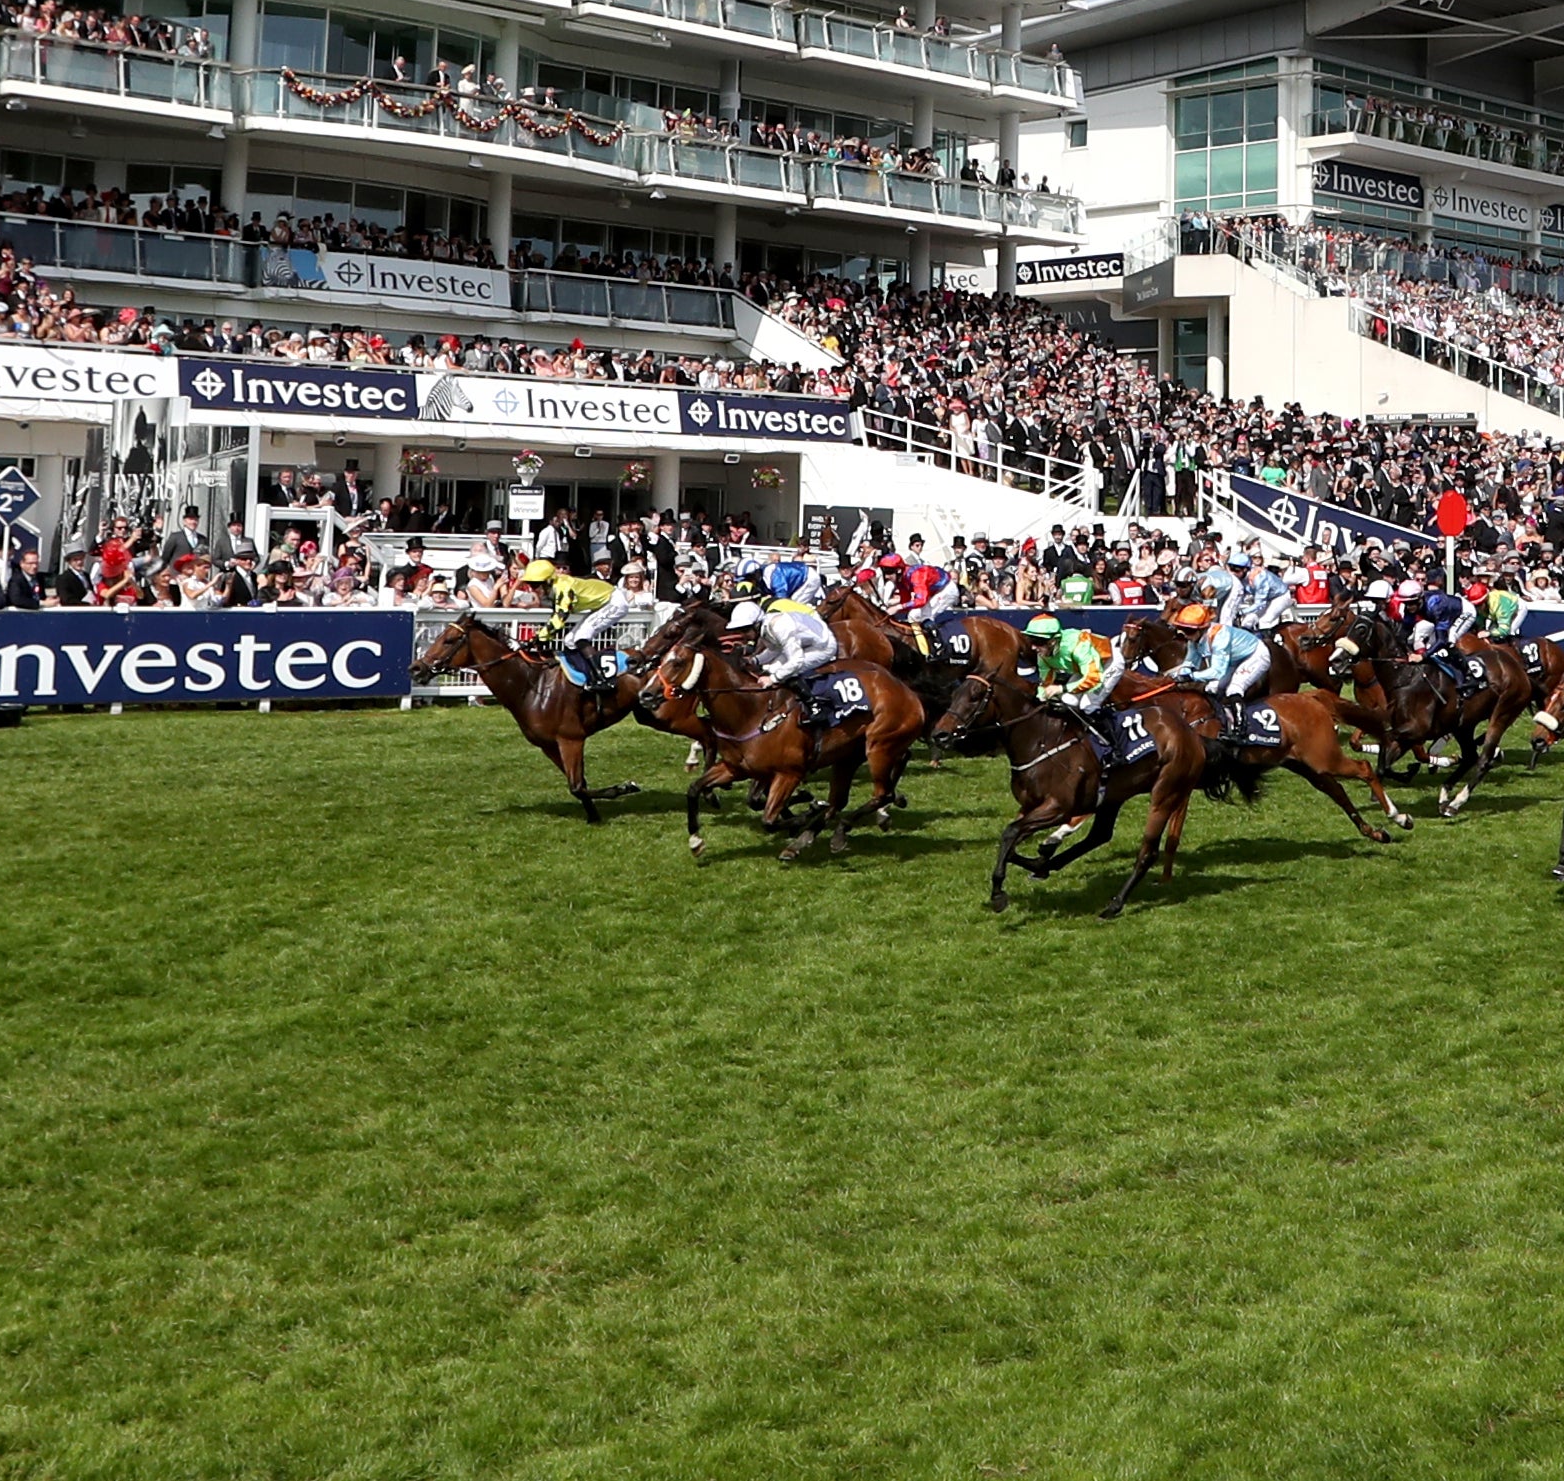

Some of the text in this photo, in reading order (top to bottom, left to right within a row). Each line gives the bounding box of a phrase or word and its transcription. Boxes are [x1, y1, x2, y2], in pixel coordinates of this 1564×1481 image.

[1332, 165, 1420, 204] Investec
[1451, 187, 1528, 224] Investec
[368, 263, 492, 299] Investec
[943, 271, 980, 289] stec
[1035, 258, 1122, 283] Investec
[233, 369, 408, 413] Investec
[526, 389, 671, 425] Investec
[717, 400, 847, 436] Investec
[949, 634, 971, 654] 10
[1522, 642, 1540, 663] 13
[600, 655, 617, 678] 5
[833, 677, 863, 703] 18
[1121, 713, 1148, 741] 11
[1252, 708, 1280, 732] 12
